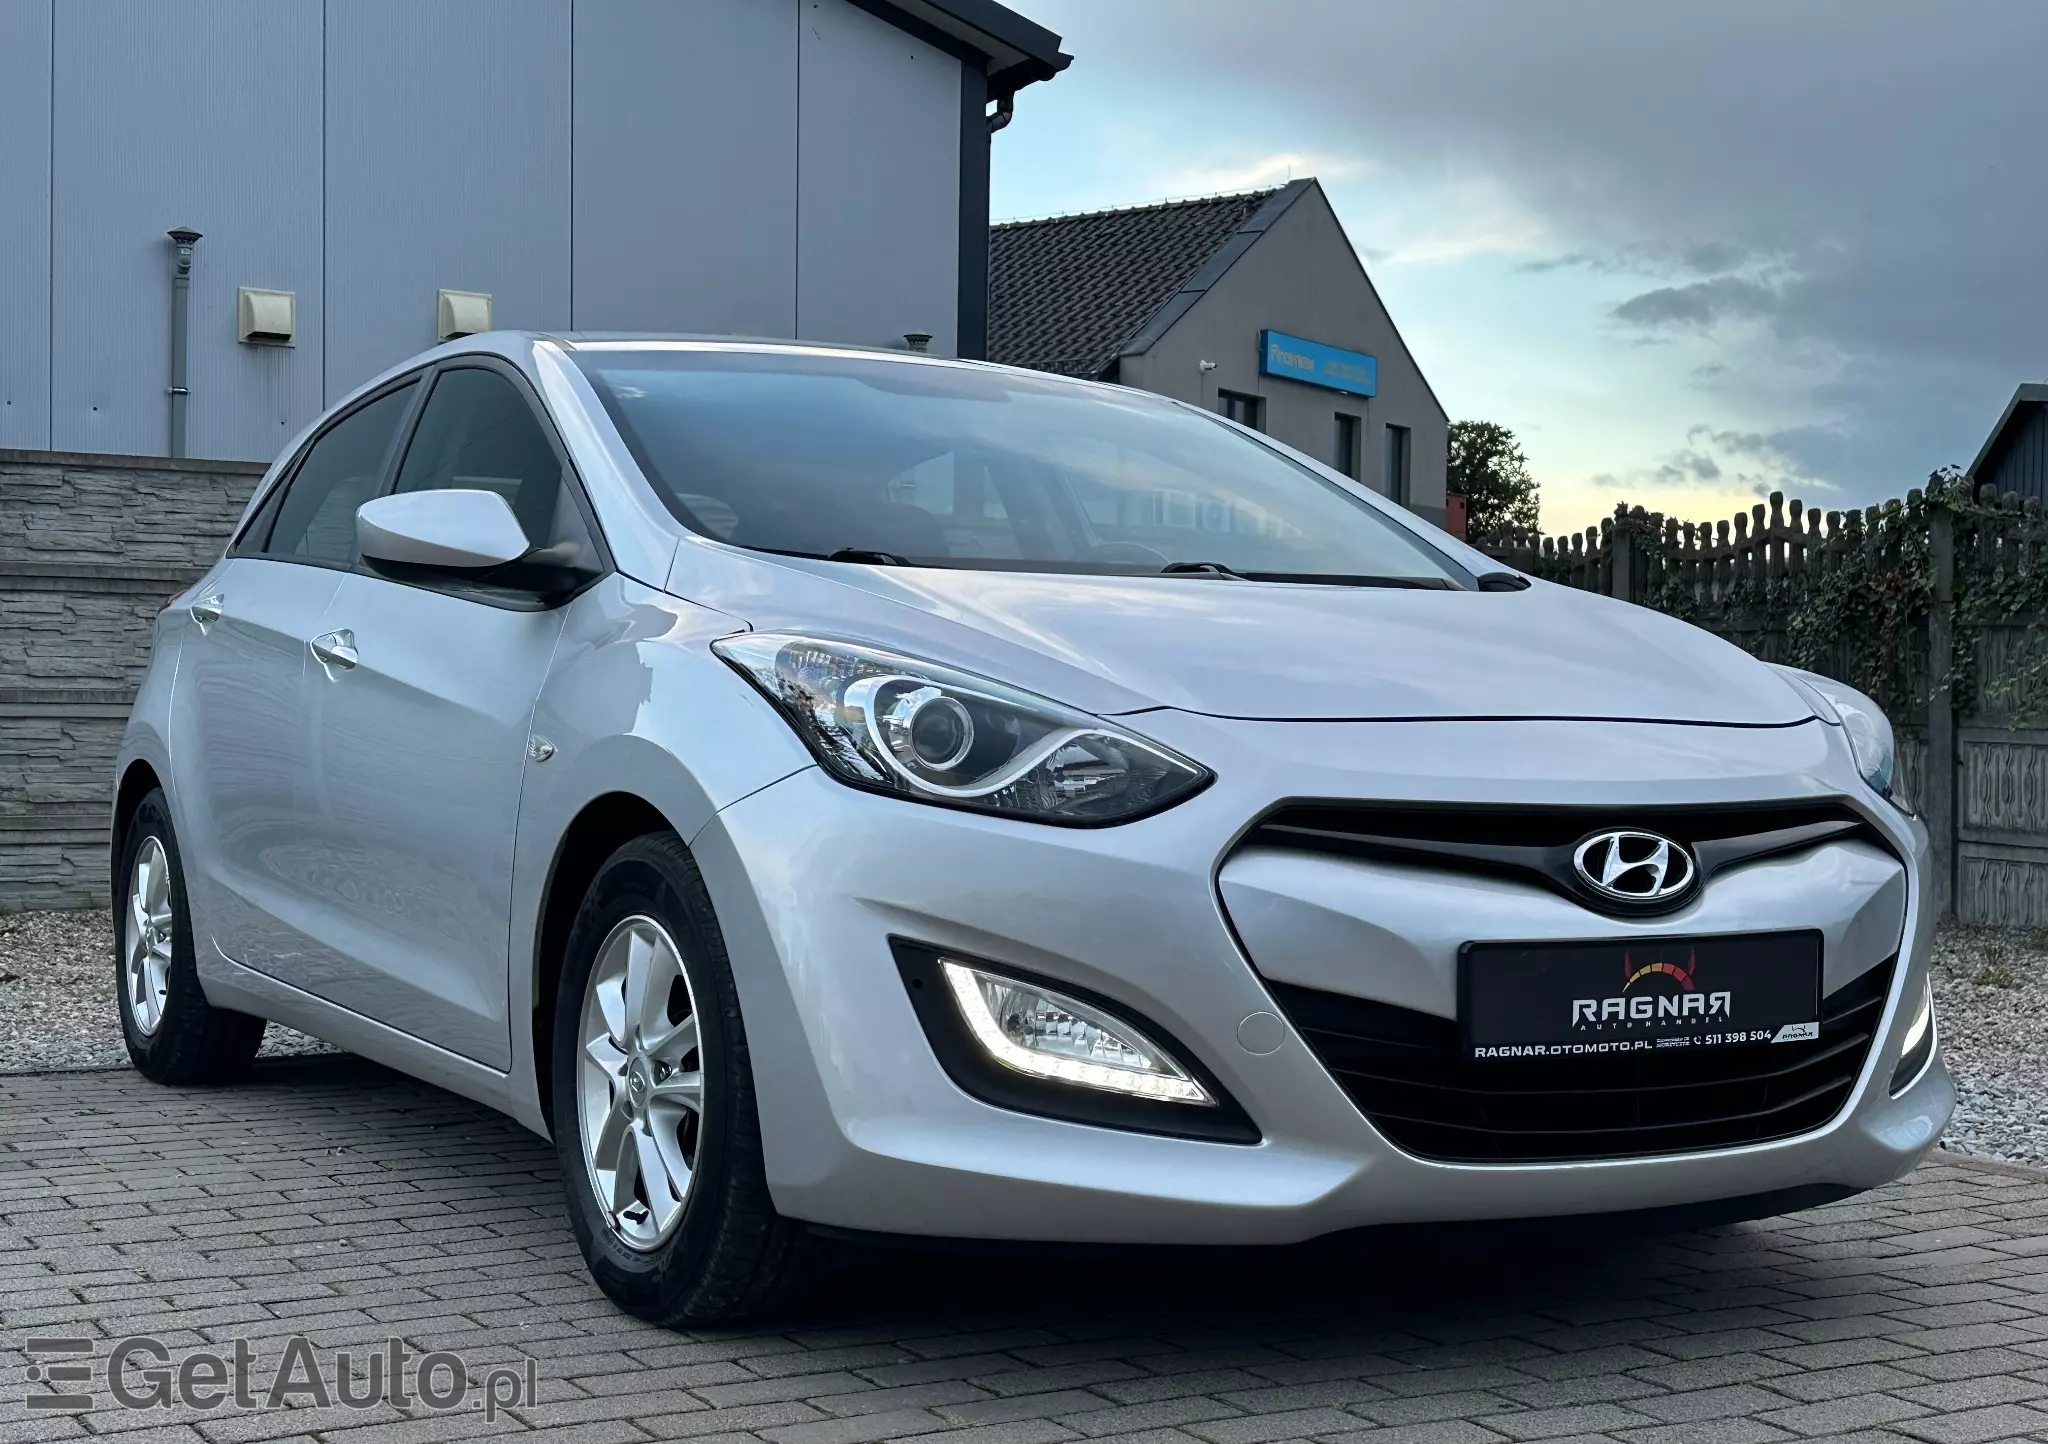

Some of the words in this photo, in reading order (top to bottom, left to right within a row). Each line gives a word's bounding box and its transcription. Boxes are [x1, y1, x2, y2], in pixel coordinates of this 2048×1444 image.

[1572, 991, 1731, 1028] RAGNAR
[1705, 1033, 1722, 1045] 511
[1725, 1032, 1747, 1043] 398
[1749, 1030, 1772, 1041] 504
[1474, 1041, 1653, 1058] RAGNAR.OTOMOTO.PL
